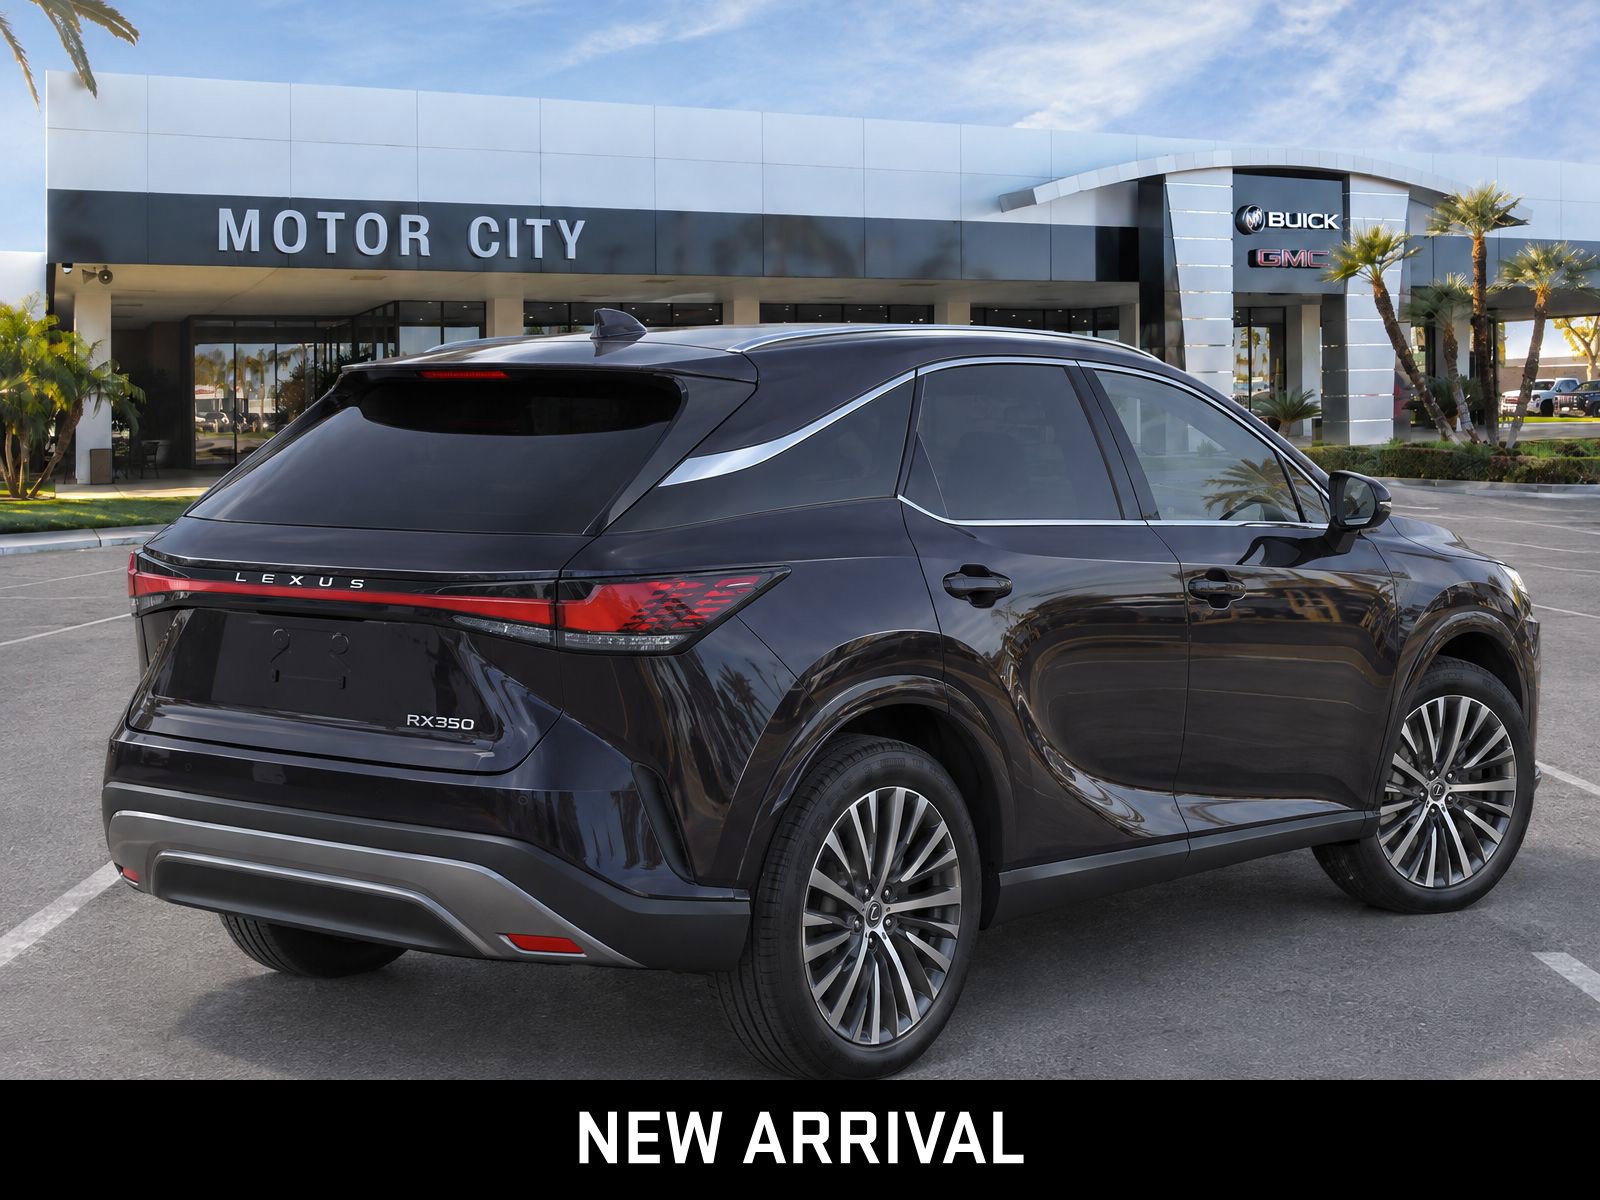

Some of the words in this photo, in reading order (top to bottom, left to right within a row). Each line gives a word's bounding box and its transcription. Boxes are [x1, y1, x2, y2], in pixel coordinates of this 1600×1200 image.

[1268, 211, 1340, 230] BUICK
[217, 208, 431, 256] MOTOR
[467, 216, 586, 260] CITY
[1257, 249, 1331, 267] GMC
[235, 572, 365, 589] LEXUS
[406, 714, 475, 730] RX350
